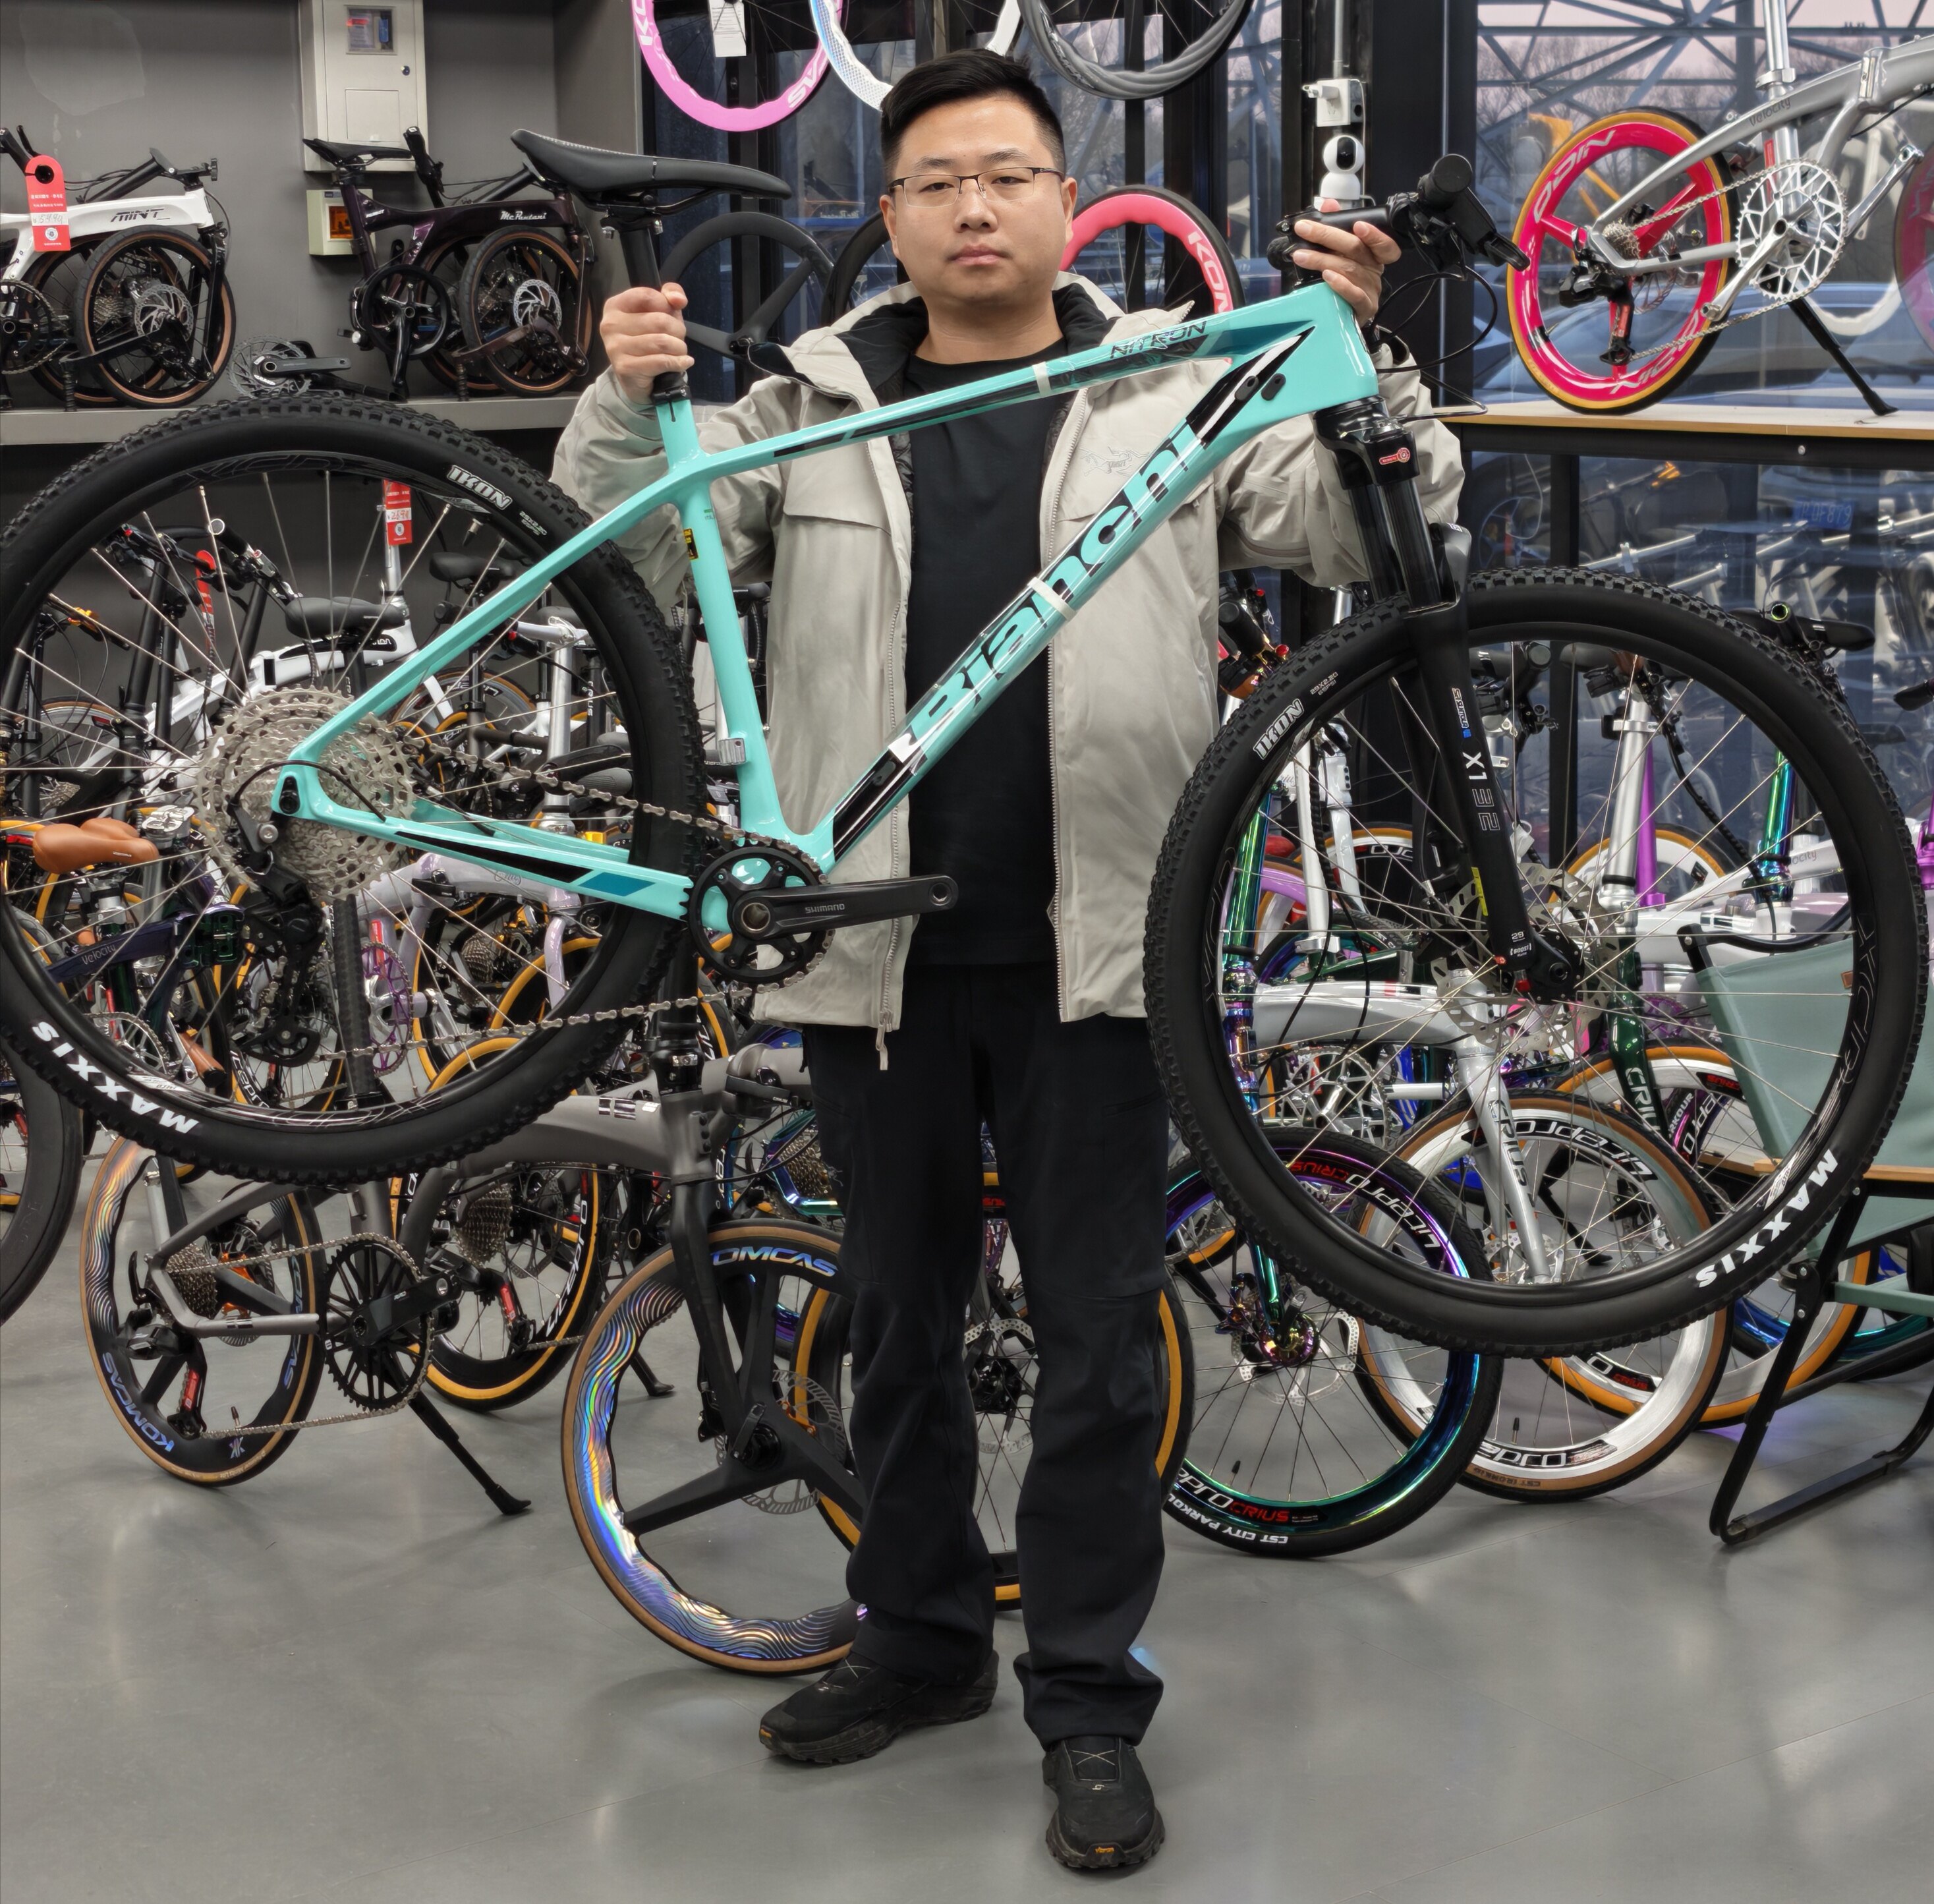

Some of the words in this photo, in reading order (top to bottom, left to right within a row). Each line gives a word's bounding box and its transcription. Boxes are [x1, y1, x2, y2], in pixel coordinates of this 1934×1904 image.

[1110, 320, 1207, 359] NITRON
[447, 465, 513, 510] IKON
[1253, 698, 1305, 760] IKON
[805, 904, 845, 914] SHIMANO
[33, 1022, 200, 1134] MAXXIS
[1695, 1148, 1838, 1288] MAXXIS
[710, 1246, 839, 1277] OMCAS
[102, 1351, 175, 1453] KOMCAS
[1168, 1493, 1221, 1530] PARKOU
[1230, 1501, 1290, 1522] CRIUS
[1222, 1526, 1257, 1541] CITY
[1259, 1535, 1289, 1544] CST
